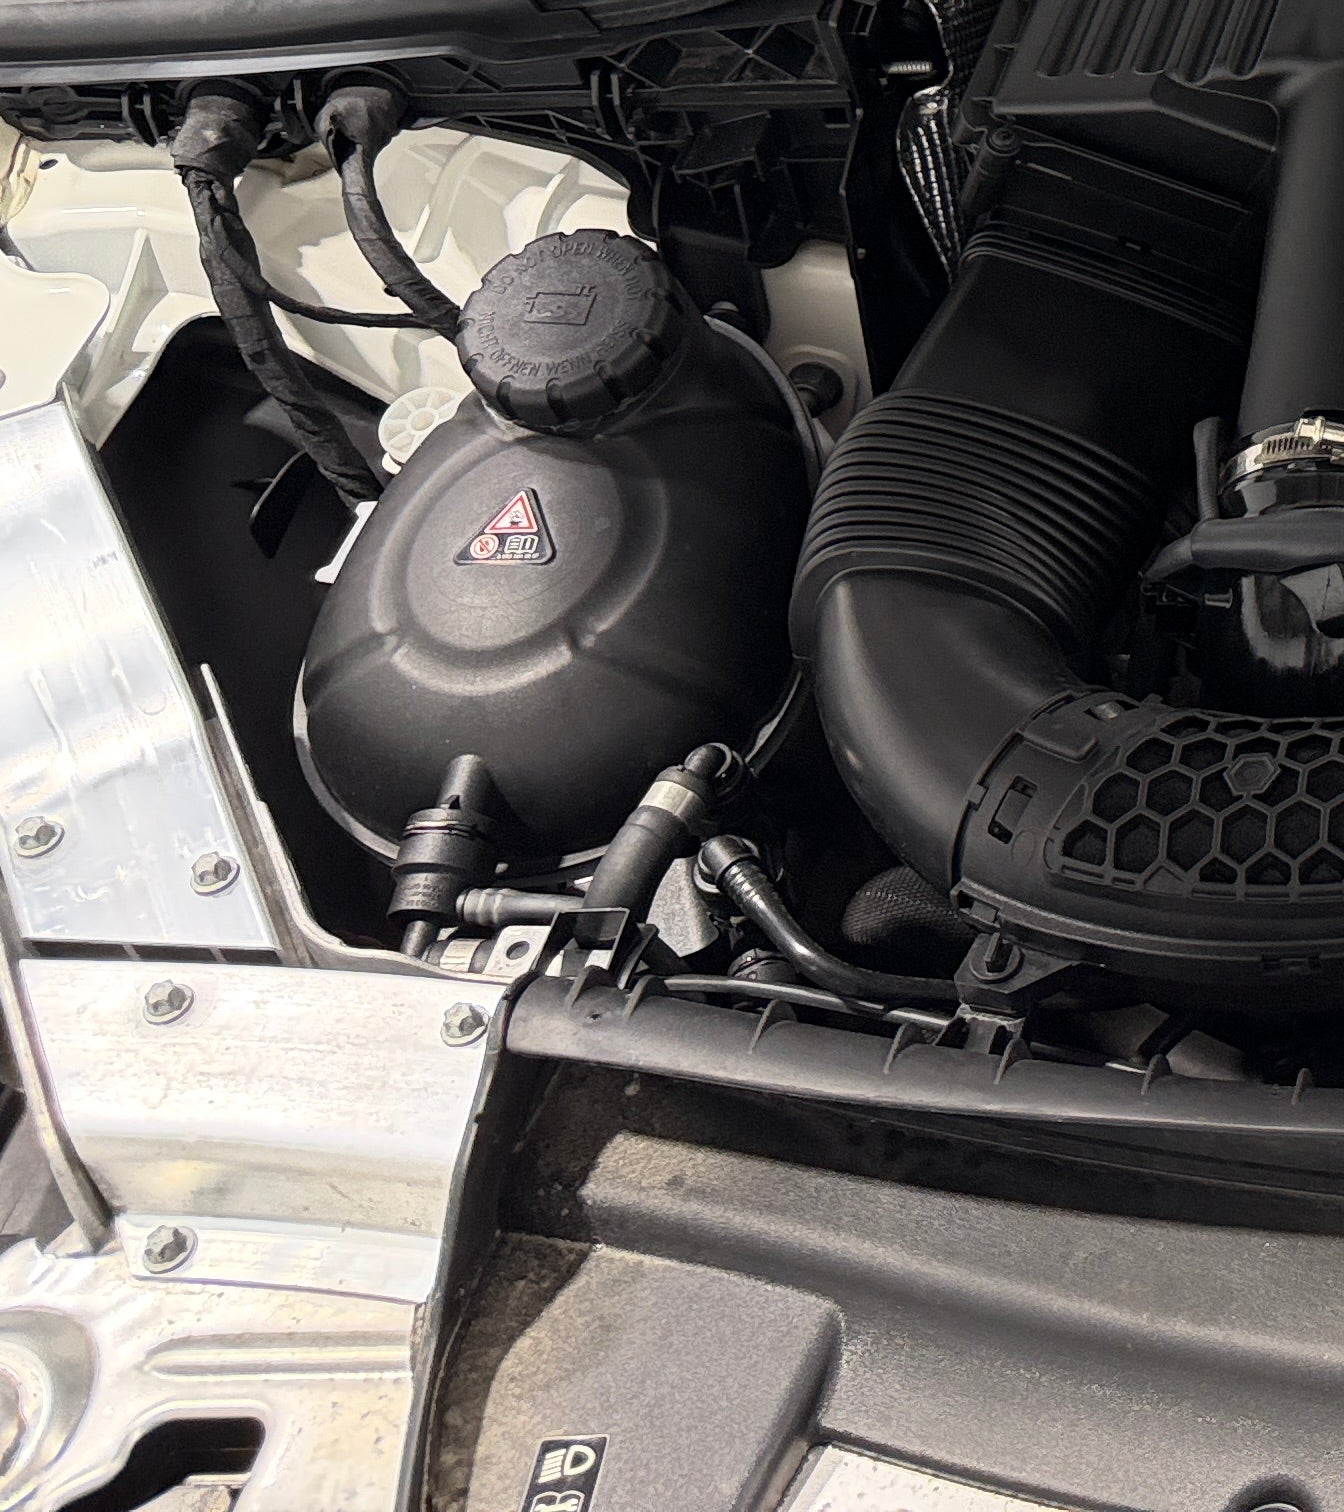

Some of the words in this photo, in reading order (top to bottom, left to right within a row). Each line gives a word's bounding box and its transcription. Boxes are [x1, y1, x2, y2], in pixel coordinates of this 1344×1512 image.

[490, 275, 515, 295] DO
[551, 239, 594, 259] OPEN
[597, 247, 633, 276] WHEN
[477, 311, 500, 349] NICHT
[544, 354, 592, 377] WENN
